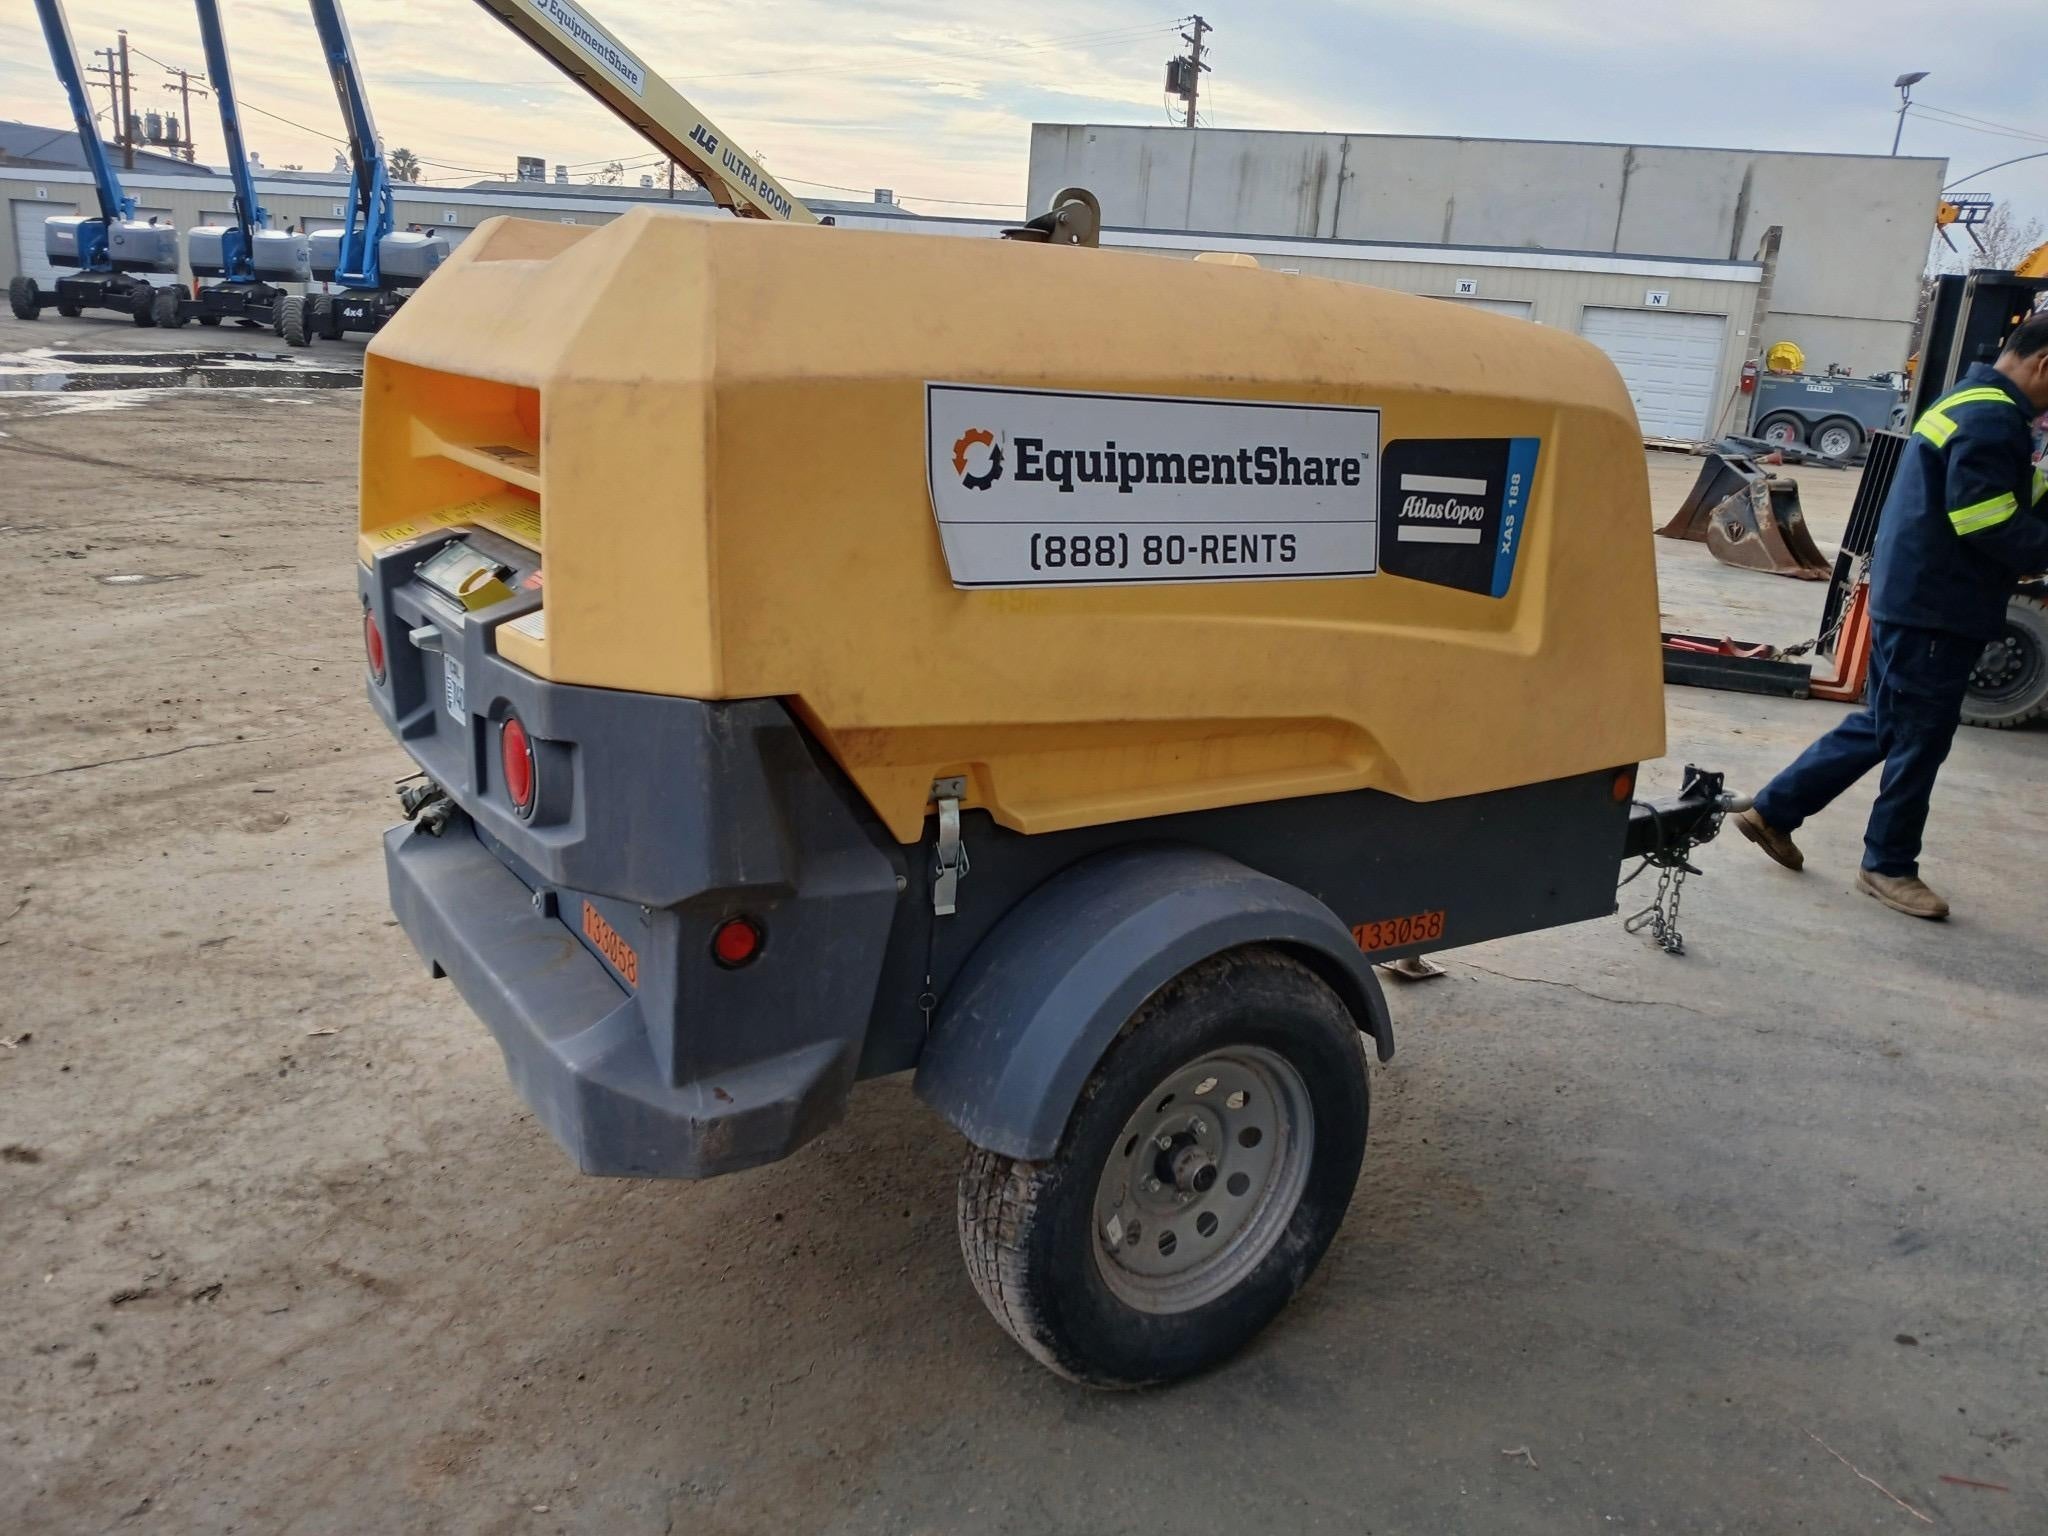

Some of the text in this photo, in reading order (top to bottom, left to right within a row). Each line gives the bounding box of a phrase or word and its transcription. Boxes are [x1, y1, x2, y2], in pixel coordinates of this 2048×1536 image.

[548, 0, 638, 84] EquipmentShare
[689, 124, 718, 155] JLG
[722, 148, 792, 220] ULTRA BOOM
[1460, 283, 1471, 293] M
[1652, 295, 1662, 304] N
[343, 307, 364, 317] 4x4
[1398, 495, 1485, 525] Atlas Copco
[1501, 473, 1521, 554] XAS 188
[1031, 533, 1297, 571] (888) 80-RENTS
[585, 904, 636, 983] 133058
[1354, 912, 1441, 950] 133058
